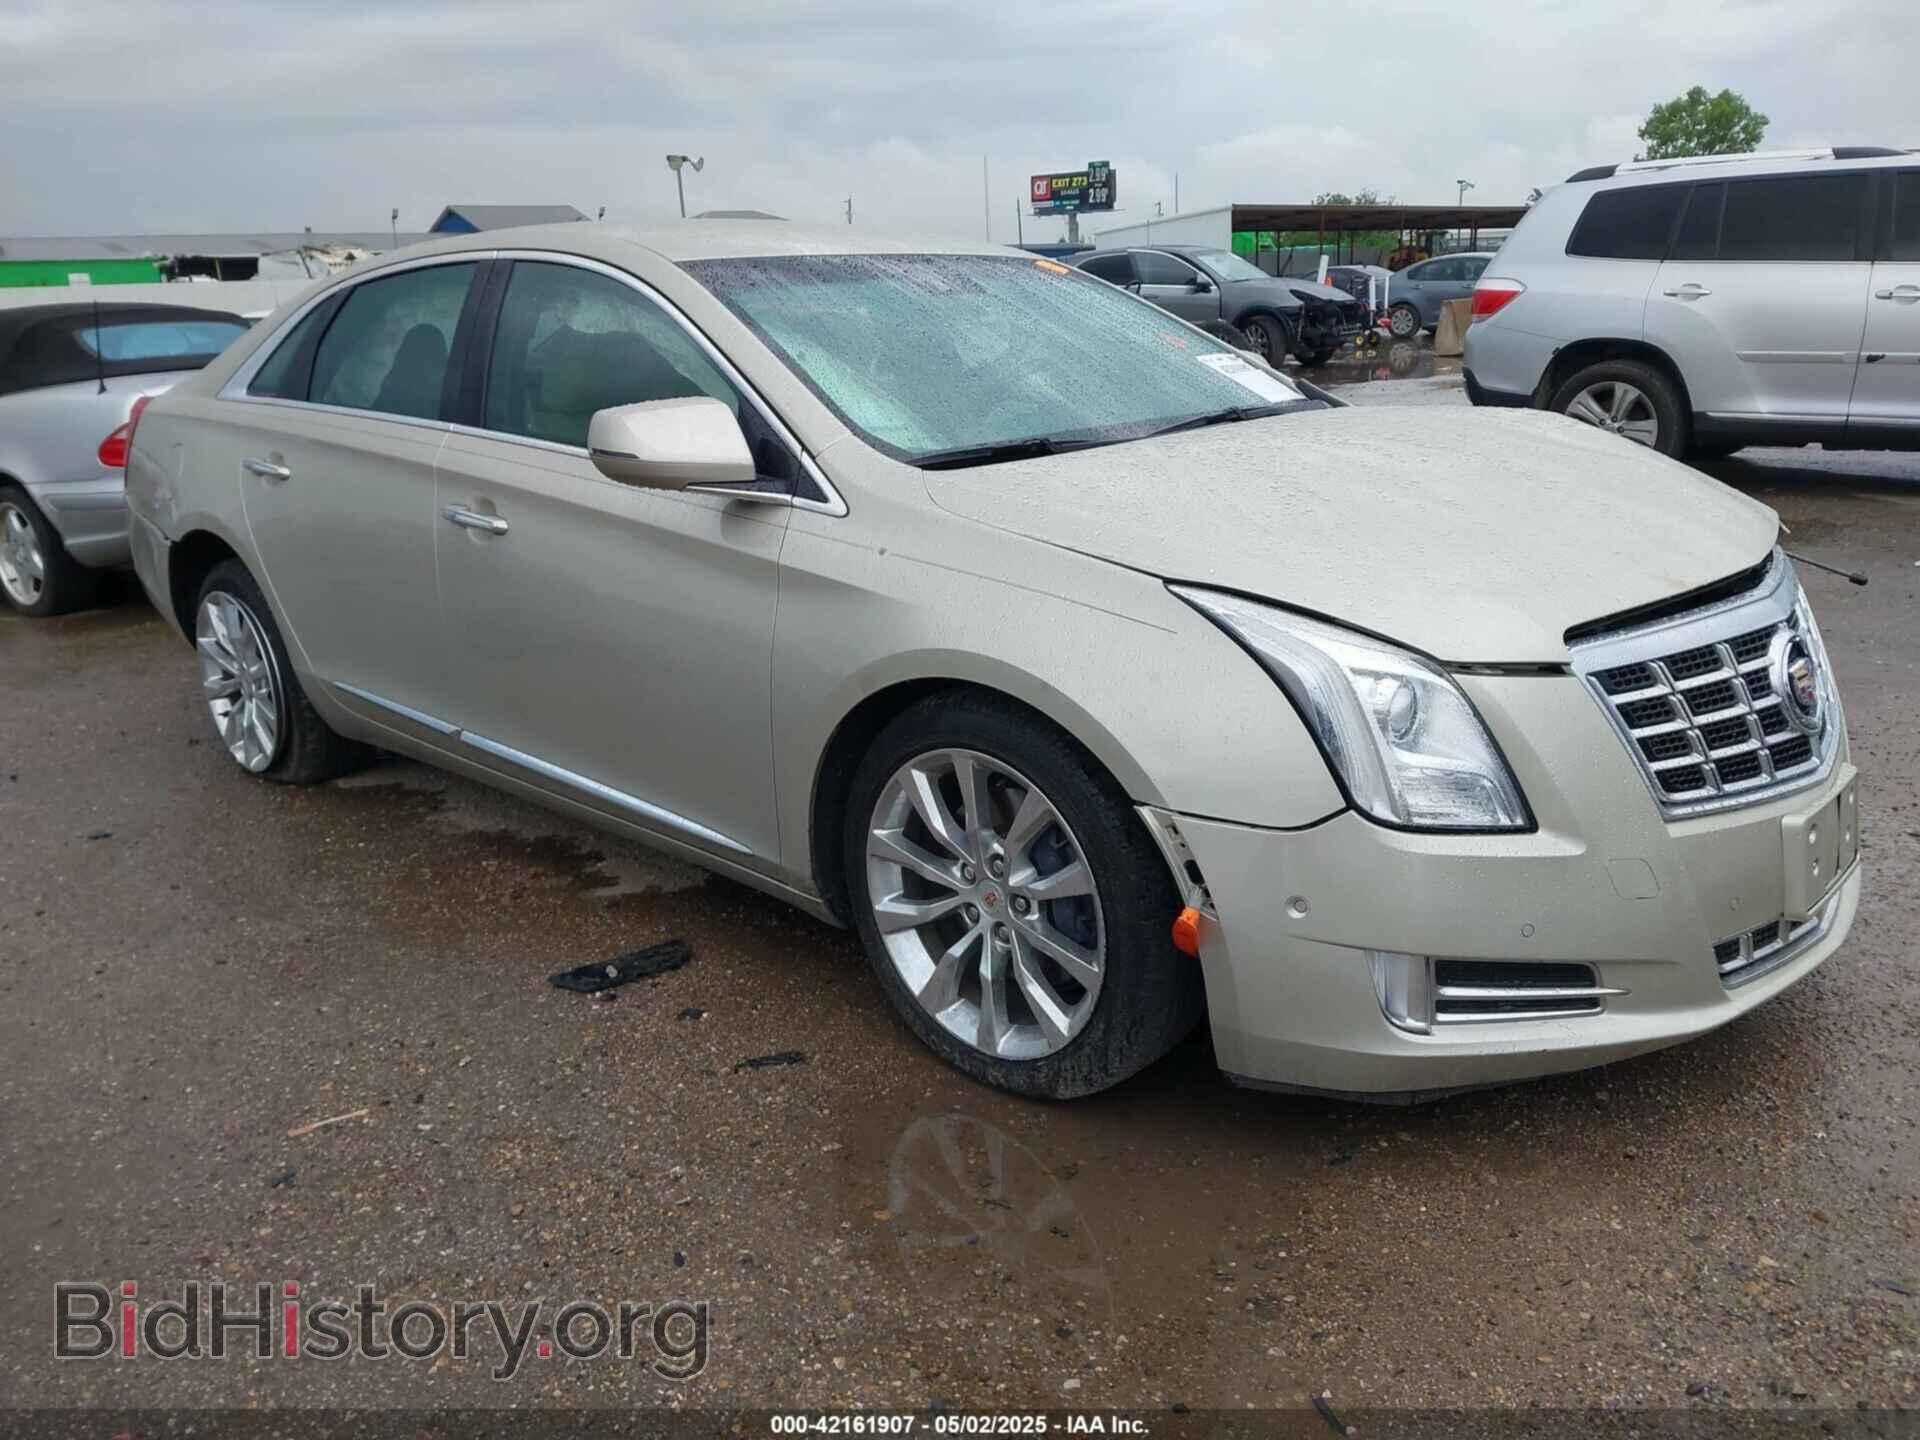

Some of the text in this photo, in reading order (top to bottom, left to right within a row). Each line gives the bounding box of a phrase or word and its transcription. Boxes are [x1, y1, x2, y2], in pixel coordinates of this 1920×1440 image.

[1034, 181, 1048, 195] QT
[1052, 176, 1088, 188] EXIT 273
